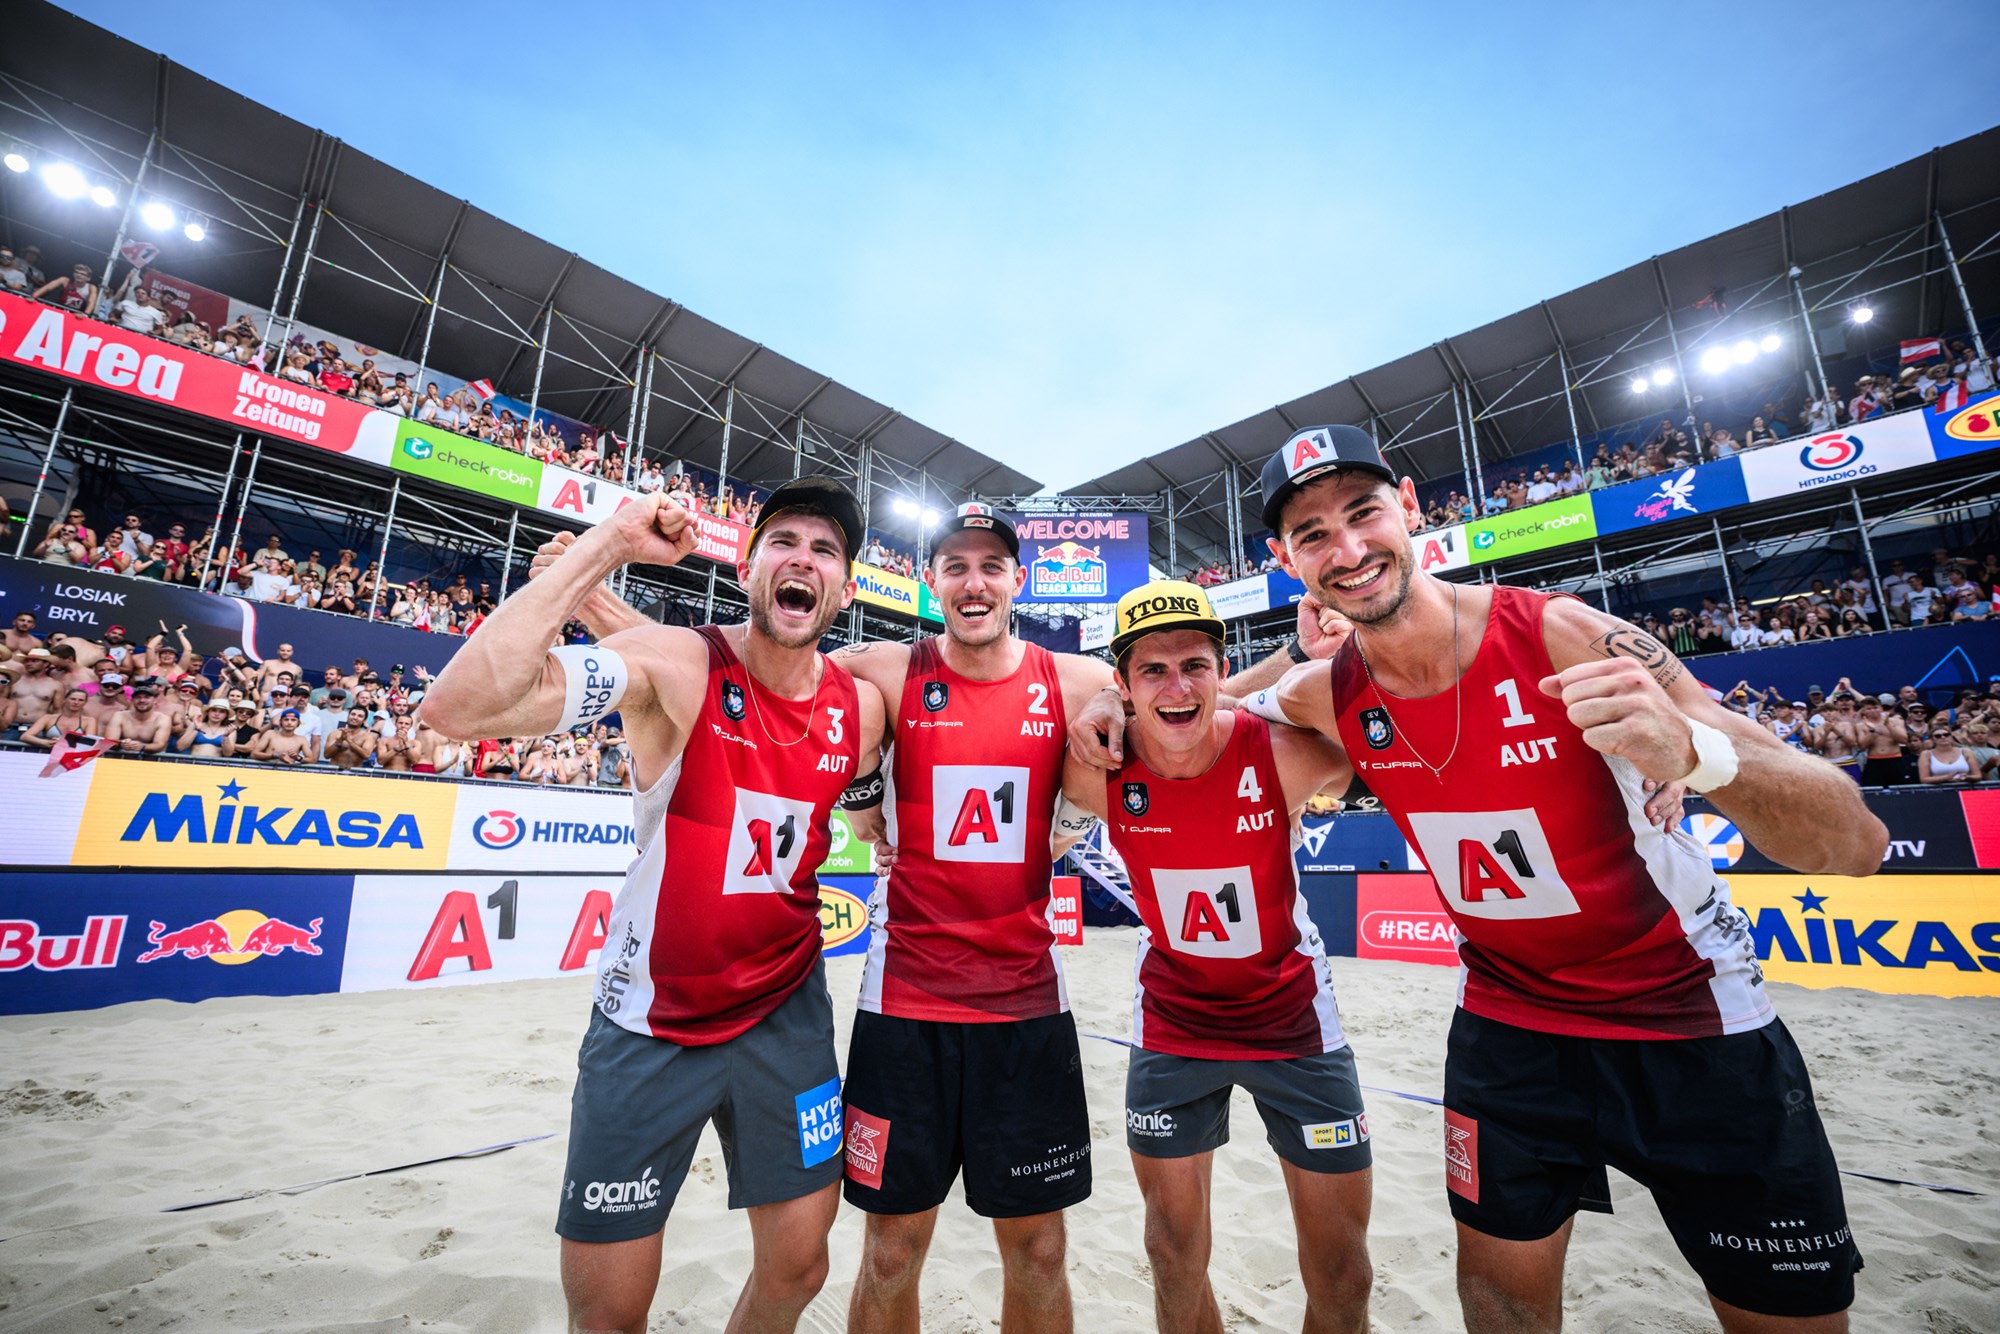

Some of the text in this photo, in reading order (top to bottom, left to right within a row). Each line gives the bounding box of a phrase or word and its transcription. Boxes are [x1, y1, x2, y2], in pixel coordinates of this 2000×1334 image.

[14, 309, 184, 401] Area
[238, 371, 326, 417] Kronen
[232, 395, 321, 440] Zeitung
[1293, 433, 1327, 471] A1
[437, 451, 533, 488] checkrobin
[1799, 469, 1856, 489] HITRADIO
[552, 479, 596, 513] A1
[691, 512, 739, 543] ronen
[1013, 520, 1129, 539] WELCOME
[1499, 513, 1587, 541] checkrobin
[695, 534, 737, 562] eitung
[1421, 531, 1454, 570] A1
[856, 575, 912, 604] MIKASA
[1036, 566, 1101, 583] Red Bull
[1036, 583, 1102, 594] BEACH ARENA
[54, 583, 127, 607] LOSIAK
[1125, 596, 1200, 623] YTONG
[48, 606, 99, 625] BRYL
[1086, 625, 1103, 634] Stadt
[1086, 633, 1104, 642] Wien
[578, 658, 600, 718] HYPO
[591, 676, 615, 717] NOE
[1027, 683, 1049, 715] 2
[1494, 678, 1535, 728] 1
[827, 707, 845, 744] 3
[1020, 720, 1055, 738] AUT
[816, 753, 849, 773] AUT
[1371, 761, 1423, 769] CUPRA
[1500, 736, 1558, 768] AUT
[840, 779, 883, 805] gani
[1237, 765, 1263, 803] 4
[120, 779, 424, 849] MIKASA
[948, 781, 1015, 846] A1
[1061, 817, 1096, 831] YPO
[1076, 815, 1097, 825] OE
[1236, 809, 1275, 834] AUT
[1458, 829, 1536, 902] A1
[1180, 882, 1242, 942] A1
[0, 915, 129, 972] Bull
[406, 879, 519, 982] A1
[559, 889, 613, 971] A
[803, 1114, 842, 1149] NOE
[1154, 1130, 1173, 1138] water
[1011, 1142, 1091, 1177] MOHNENFLUH
[583, 1166, 660, 1211] ganic
[1044, 1168, 1076, 1183] echte berge
[601, 1199, 658, 1214] vitamin water
[1709, 1223, 1851, 1253] MOHNENFLUH
[1772, 1260, 1831, 1272] echte berge
